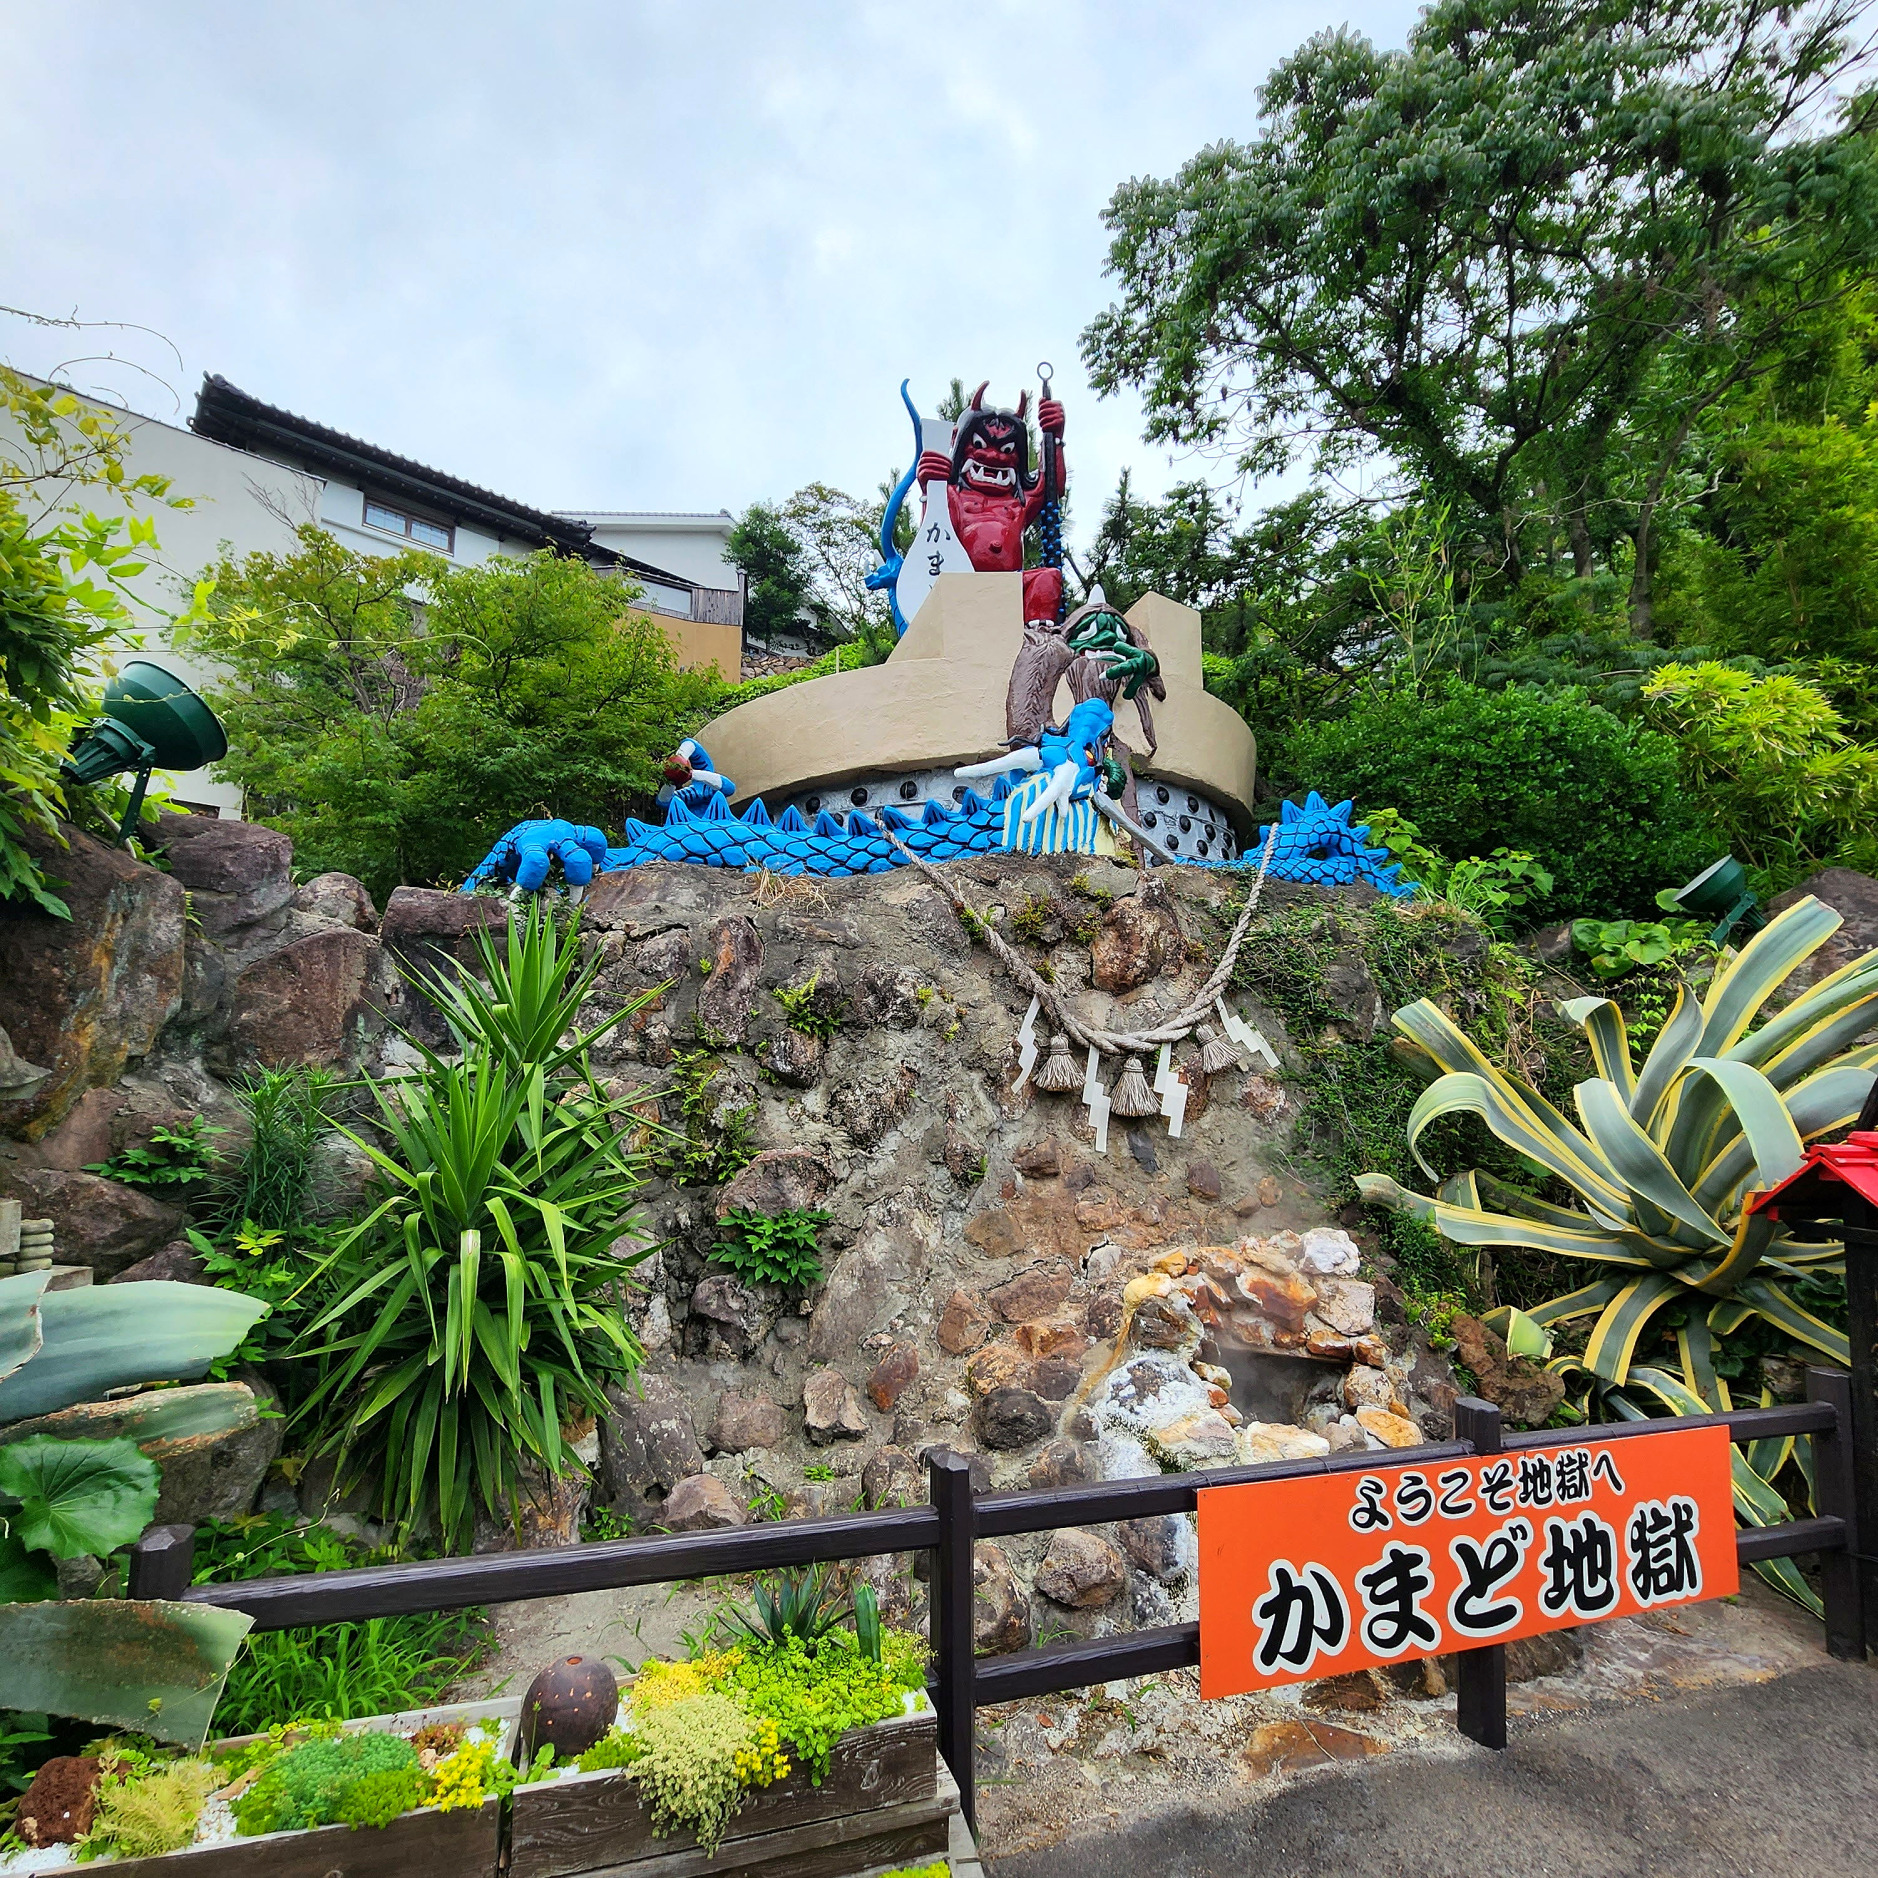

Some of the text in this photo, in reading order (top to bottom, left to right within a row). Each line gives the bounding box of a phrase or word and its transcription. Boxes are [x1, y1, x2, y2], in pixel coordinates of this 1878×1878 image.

[926, 522, 951, 590] かま
[1350, 1449, 1625, 1532] ようこそ地獄へ
[1253, 1496, 1702, 1674] かまど地獄
